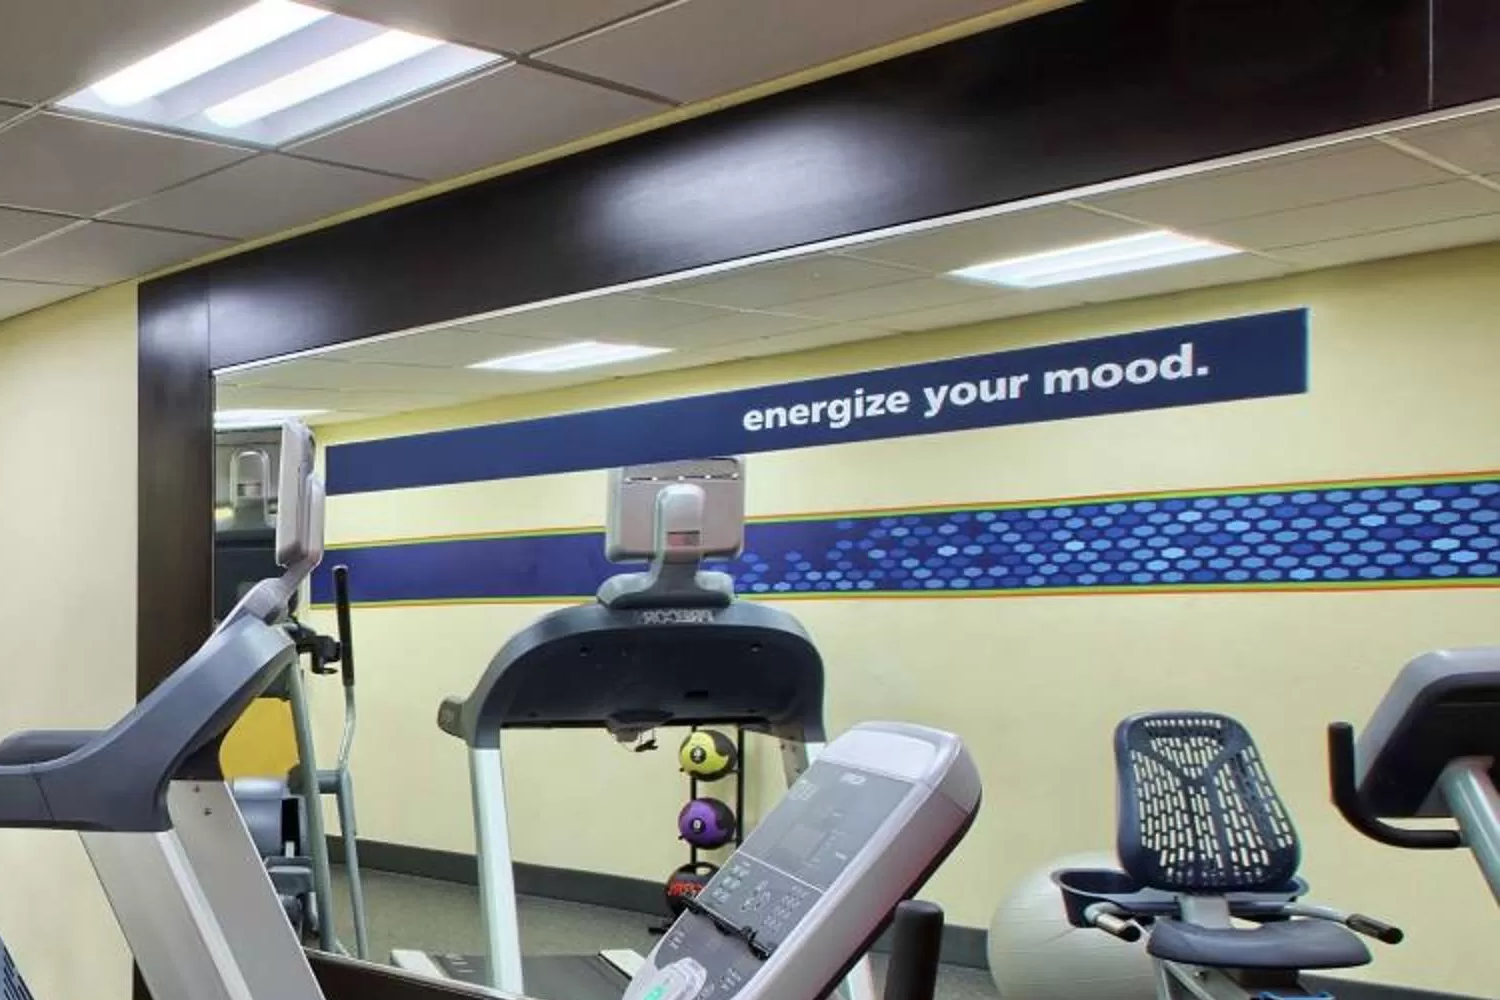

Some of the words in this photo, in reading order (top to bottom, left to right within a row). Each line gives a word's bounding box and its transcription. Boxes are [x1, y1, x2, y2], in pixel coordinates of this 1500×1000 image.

[742, 387, 910, 433] energize
[923, 373, 1029, 417] your
[1042, 342, 1209, 396] mood.
